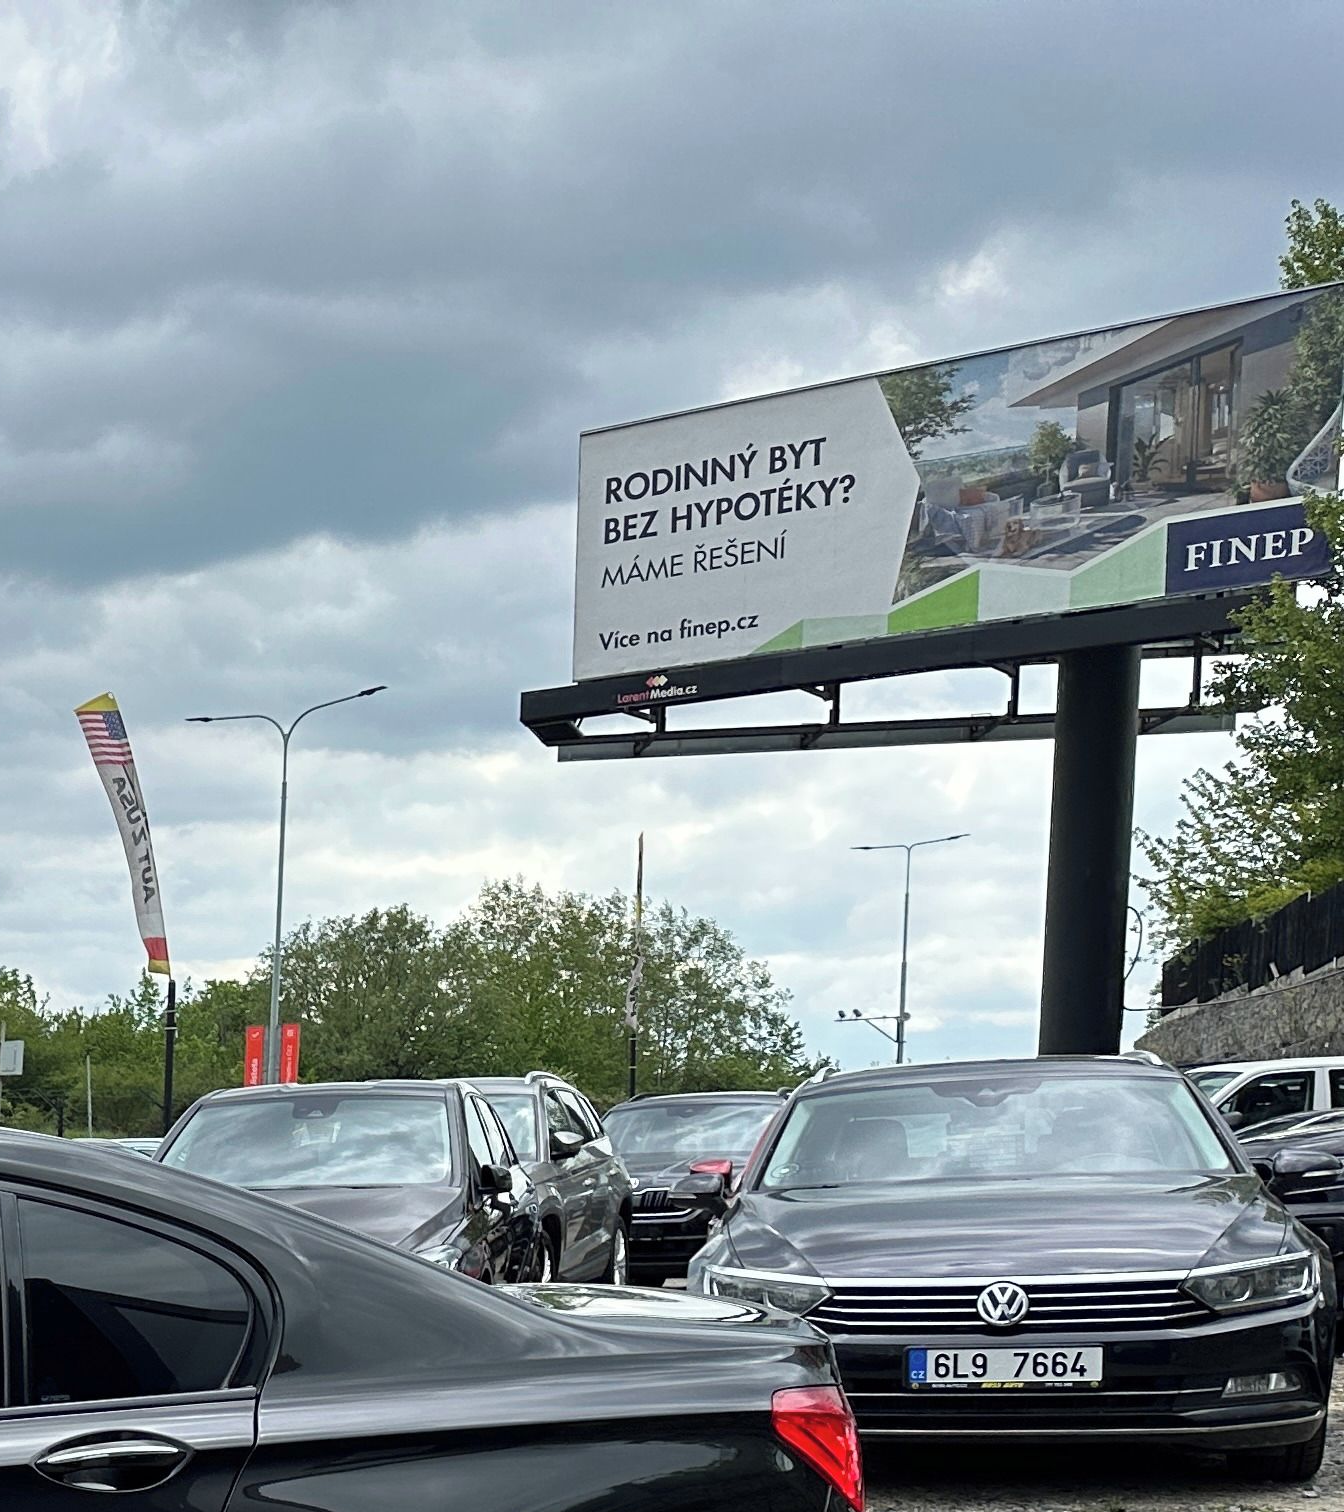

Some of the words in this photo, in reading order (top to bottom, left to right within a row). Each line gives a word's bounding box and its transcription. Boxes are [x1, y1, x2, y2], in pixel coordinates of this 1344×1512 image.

[605, 442, 758, 504] RODINNÝ
[768, 437, 826, 474] BYT
[603, 509, 659, 545] BEZ
[671, 474, 855, 533] HYPOTÉKY?
[601, 554, 684, 588] MÁME
[693, 529, 788, 573] ŘEŠENÍ
[1184, 527, 1314, 572] FINEP
[599, 630, 640, 650] Více
[647, 628, 672, 644] na
[680, 614, 759, 639] finep.cz
[617, 684, 698, 704] LarentMedia.cz
[911, 1370, 925, 1379] CZ
[934, 1353, 988, 1379] 6L9
[1013, 1352, 1088, 1378] 7664
